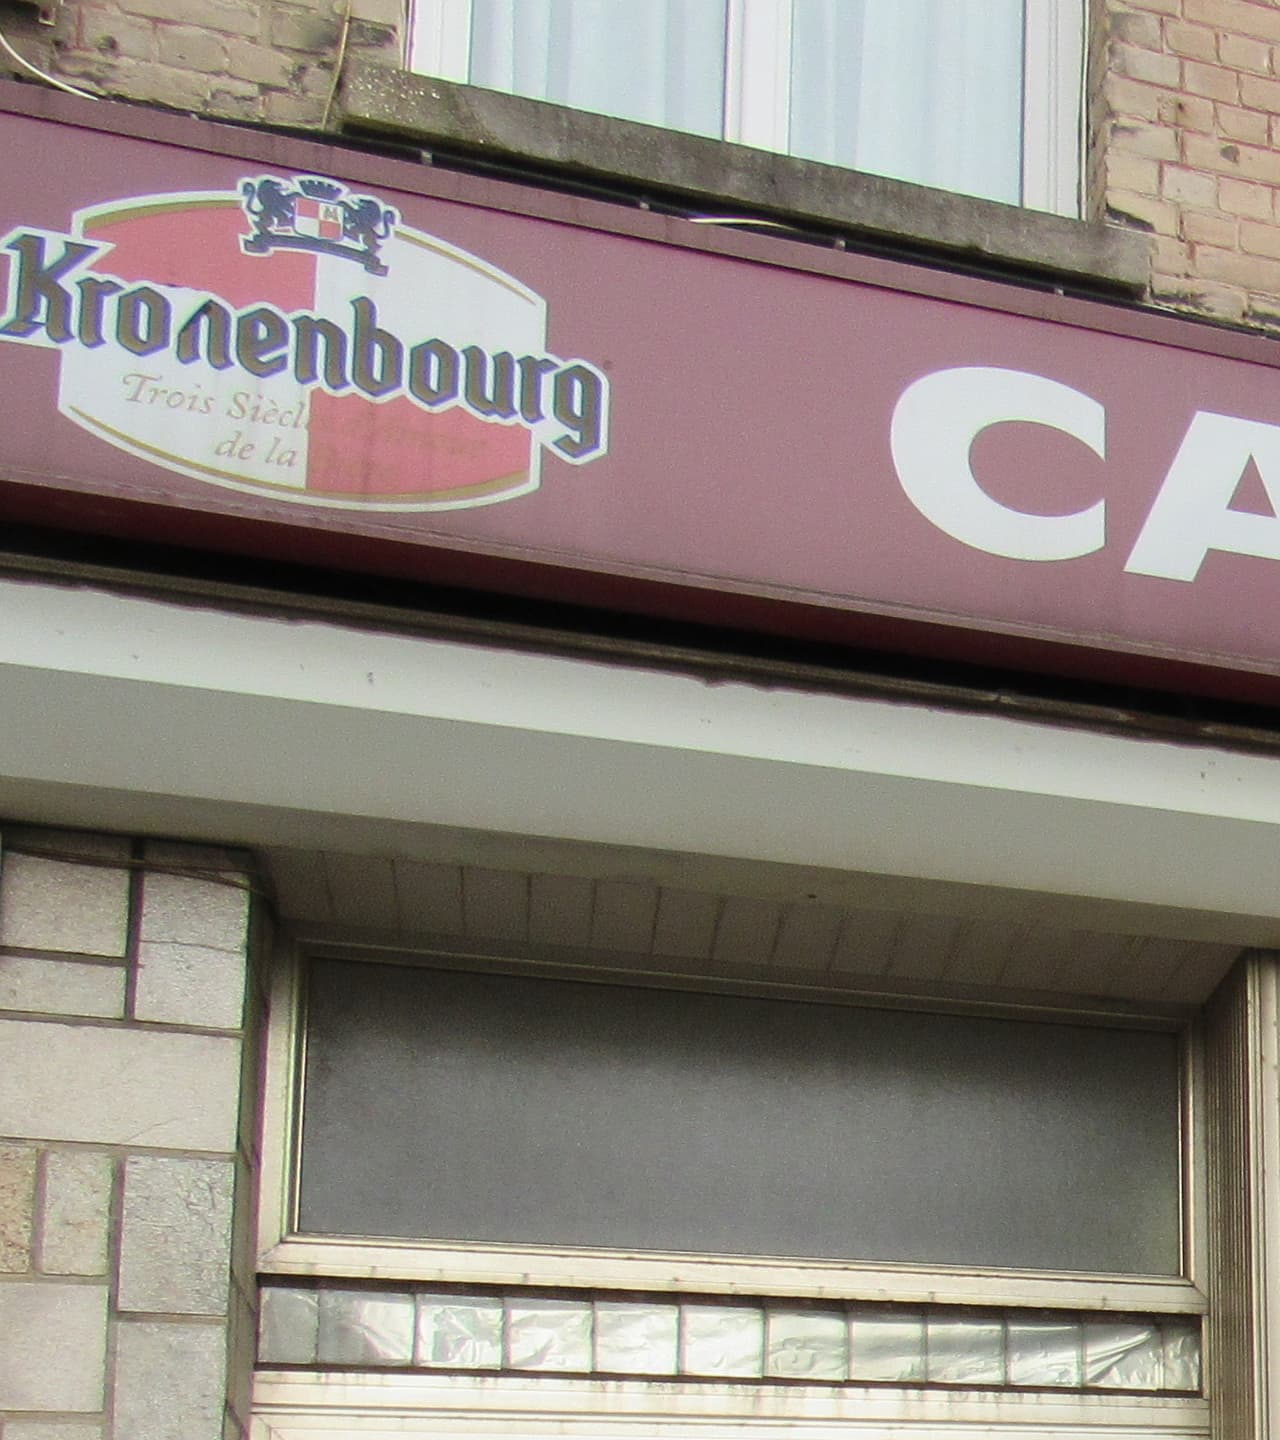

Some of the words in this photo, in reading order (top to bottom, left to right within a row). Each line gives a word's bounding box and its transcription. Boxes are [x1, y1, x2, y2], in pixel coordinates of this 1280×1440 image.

[3, 233, 604, 460] Kronenbourg
[122, 373, 215, 415] Trois
[214, 431, 254, 461] de
[264, 439, 299, 468] la
